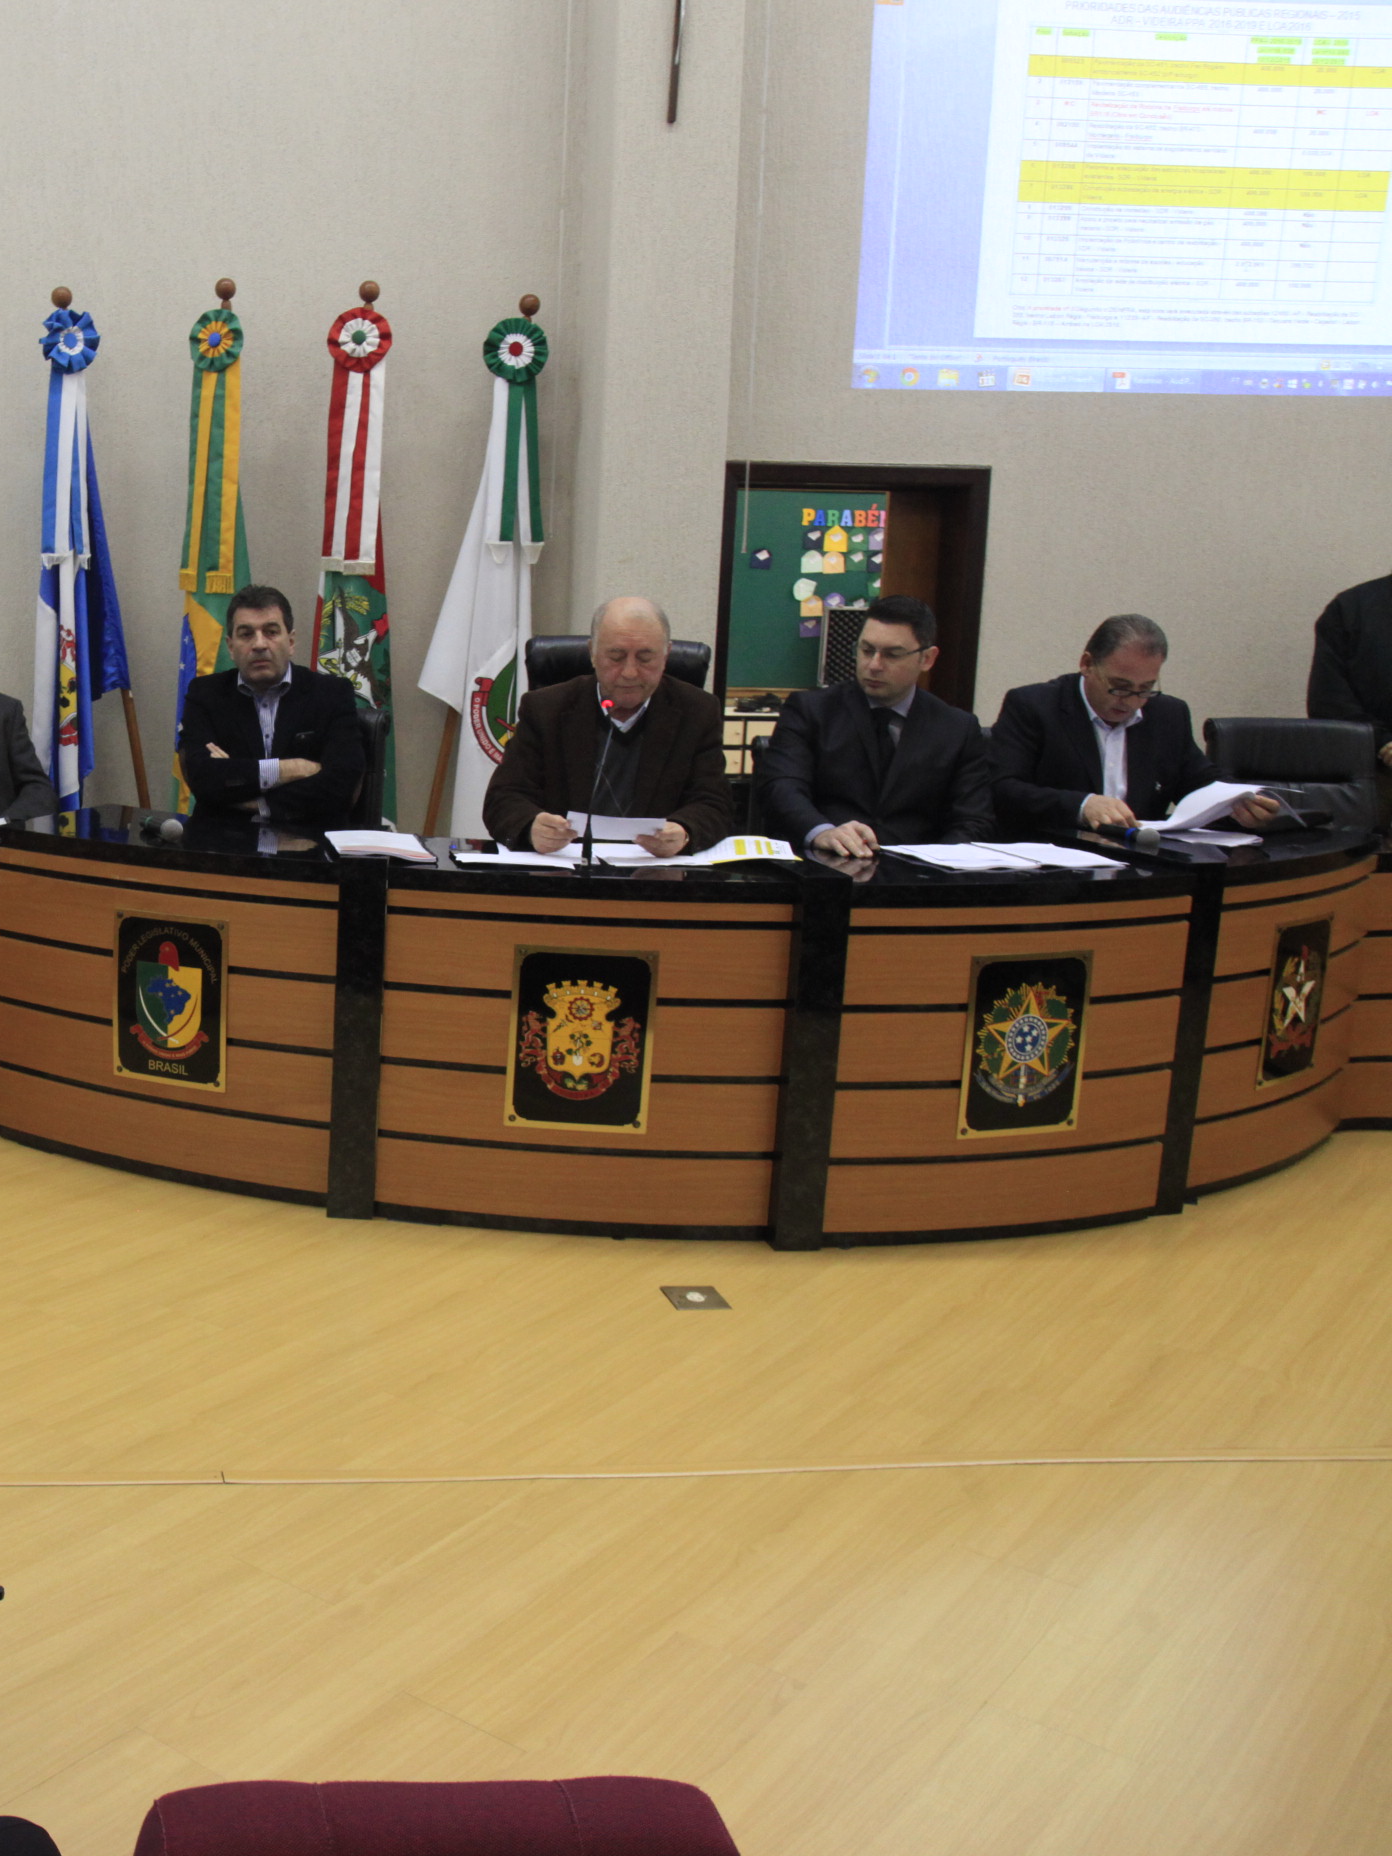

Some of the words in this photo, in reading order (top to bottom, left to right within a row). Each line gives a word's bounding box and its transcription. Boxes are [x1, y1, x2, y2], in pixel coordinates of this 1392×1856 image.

[121, 943, 140, 974] PODER
[138, 926, 189, 947] LEGISLATIVO
[189, 938, 218, 985] MUNICIPAL
[148, 1059, 189, 1076] BRASIL
